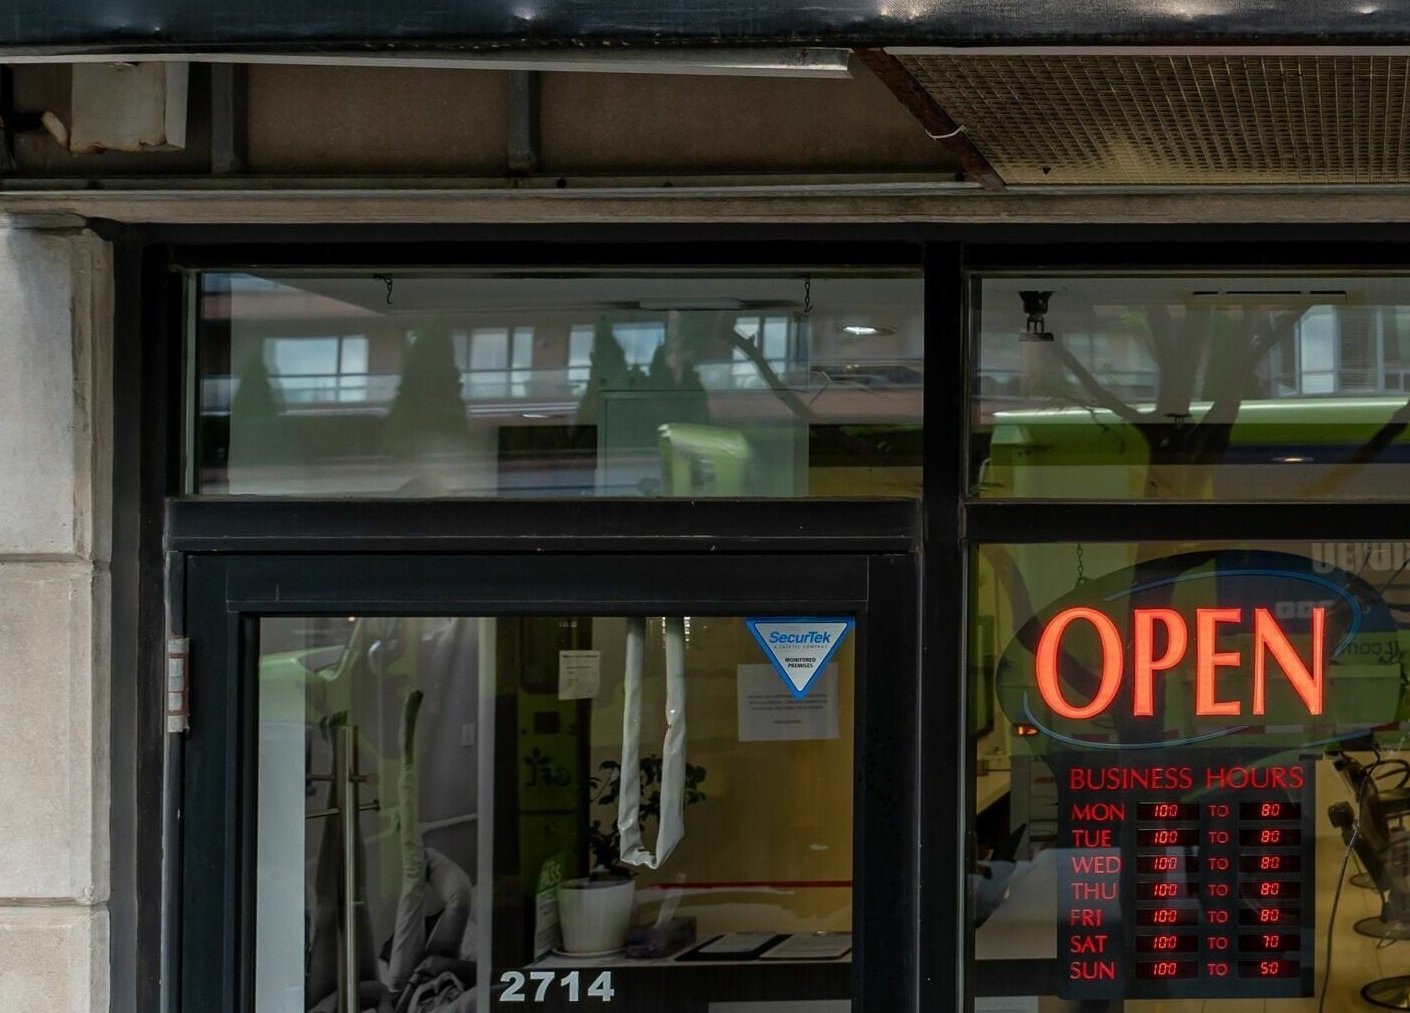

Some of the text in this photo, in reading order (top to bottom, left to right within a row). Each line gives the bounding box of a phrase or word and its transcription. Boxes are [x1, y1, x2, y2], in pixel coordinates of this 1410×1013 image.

[769, 630, 832, 644] SecurTek
[1034, 606, 1326, 720] OPEN
[1070, 766, 1304, 790] BUSINESS HOURS
[1072, 802, 1126, 822] MON
[1210, 804, 1230, 817] TO
[1073, 828, 1111, 848] TUE
[1210, 831, 1230, 844] TO
[1073, 856, 1123, 874] WED
[1210, 858, 1229, 870] TO
[1074, 883, 1116, 899] THU
[1209, 884, 1230, 896] TO
[1070, 908, 1102, 927] FRI
[1208, 910, 1229, 923] TO
[1070, 934, 1107, 954] SAT
[1208, 937, 1228, 950] TO
[1071, 961, 1116, 980] SUN
[1208, 962, 1229, 975] TO
[500, 971, 615, 1002] 2714
